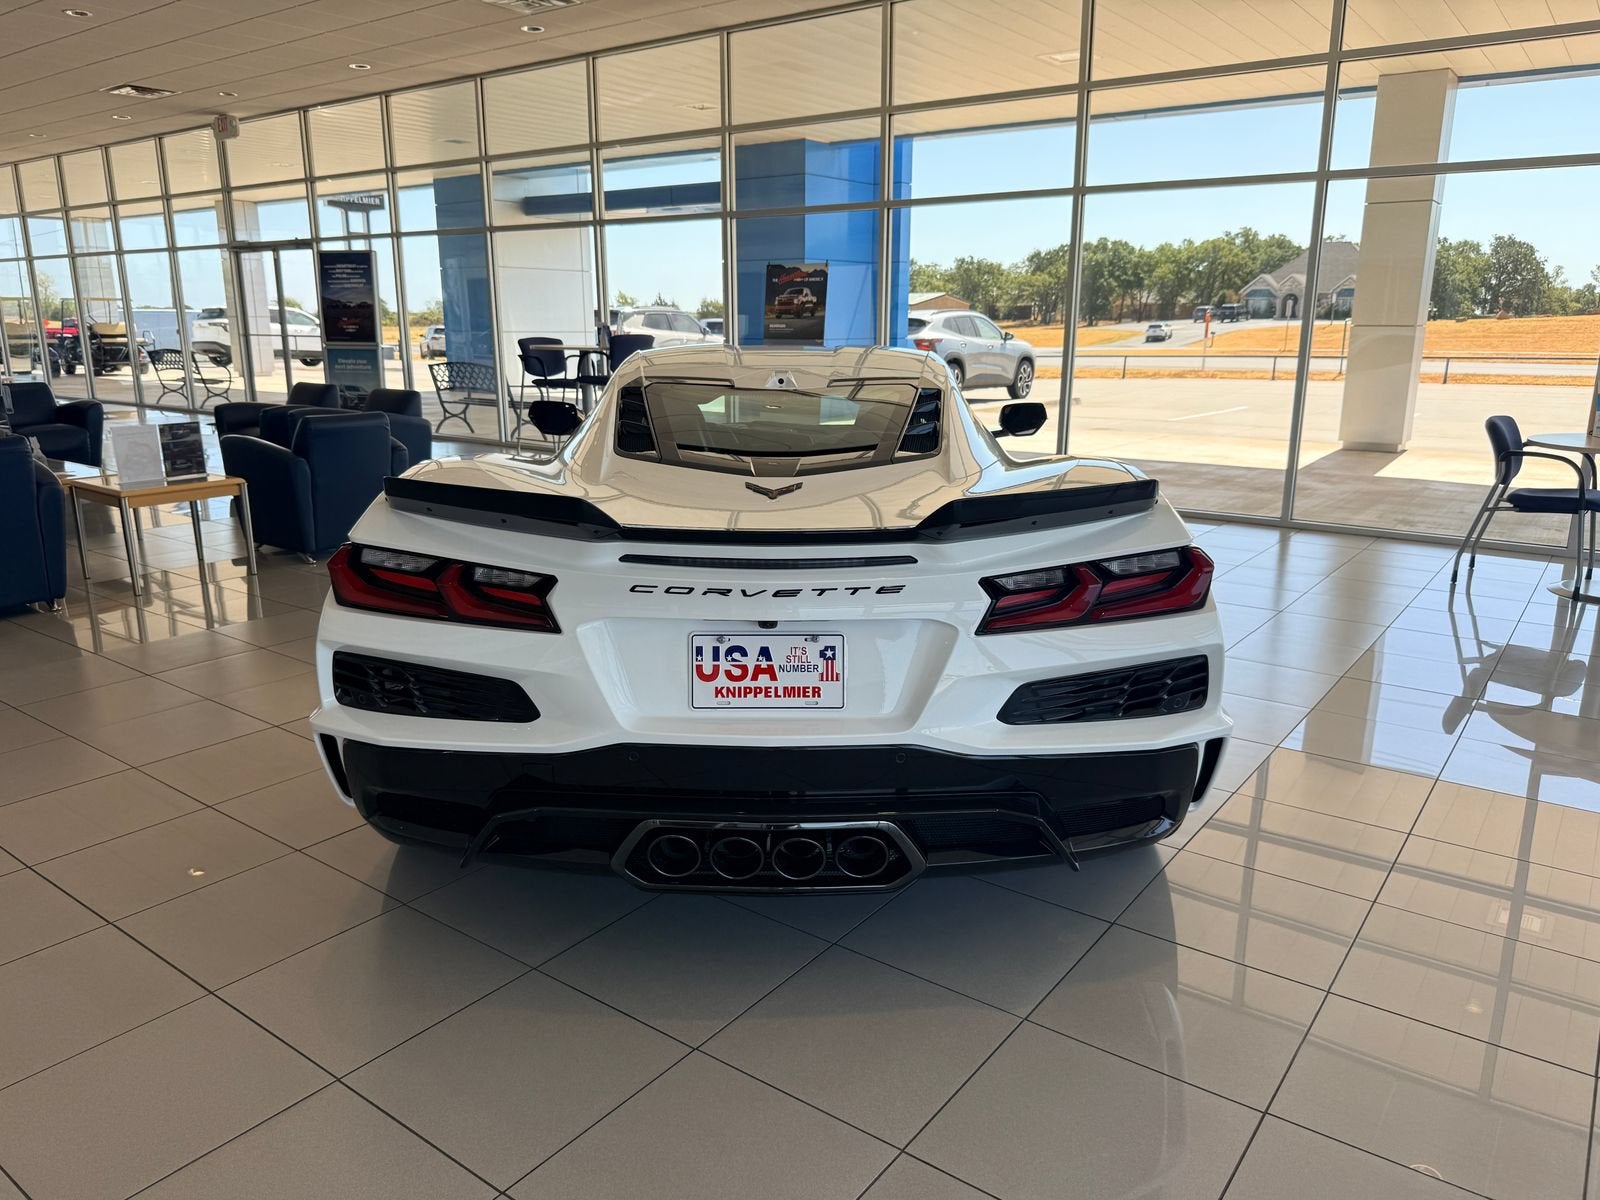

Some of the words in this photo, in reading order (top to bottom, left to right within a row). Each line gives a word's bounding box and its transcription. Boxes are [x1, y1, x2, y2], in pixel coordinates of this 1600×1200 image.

[629, 584, 906, 598] CORVETTE
[790, 646, 807, 655] IT'S
[696, 645, 778, 682] USA
[785, 655, 811, 664] STILL
[778, 664, 819, 673] NUMBER
[714, 686, 821, 698] KNIPPELMIER
